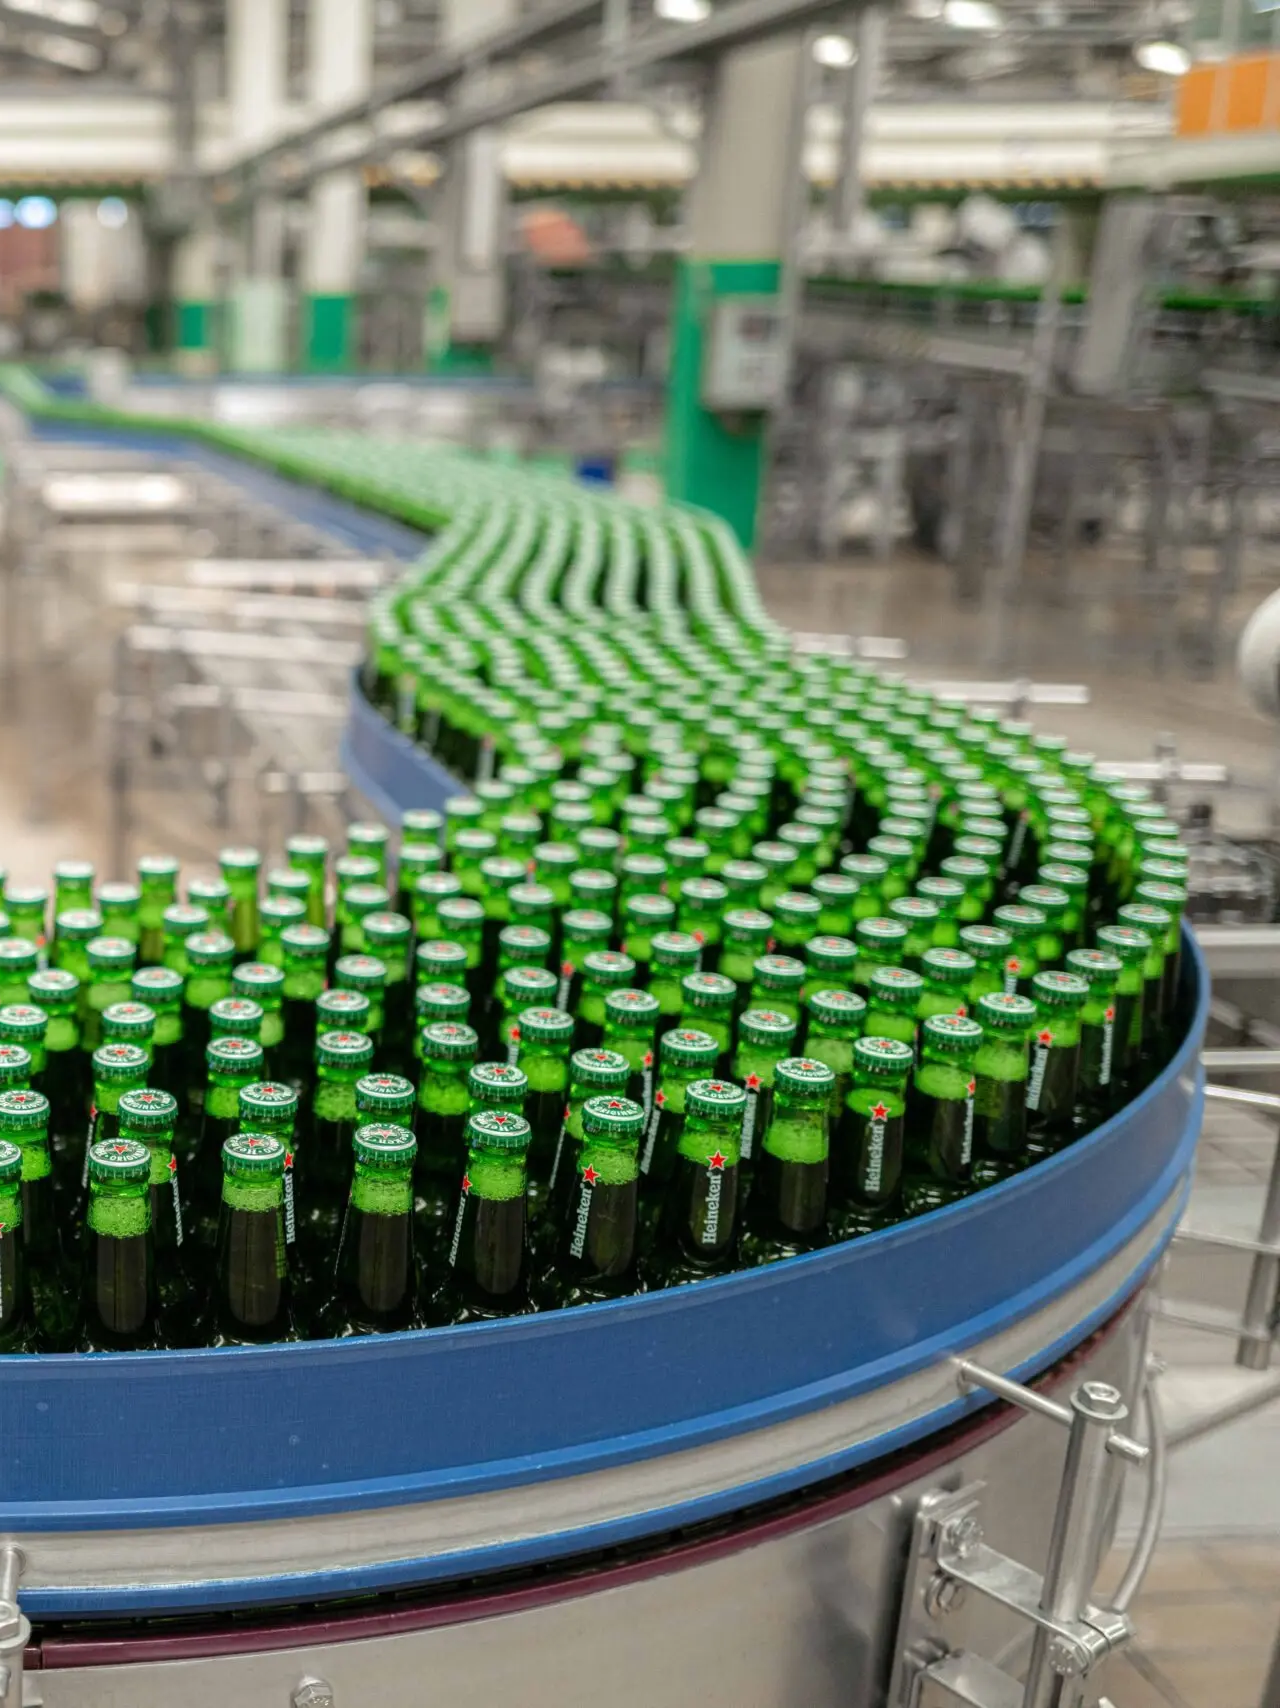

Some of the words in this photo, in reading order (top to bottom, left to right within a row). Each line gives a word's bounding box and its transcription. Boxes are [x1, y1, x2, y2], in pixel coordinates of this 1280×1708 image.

[864, 1123, 885, 1193] Heineken
[283, 1173, 296, 1245] Heineken
[570, 1188, 593, 1259] Heineken
[702, 1173, 722, 1244] Heineken
